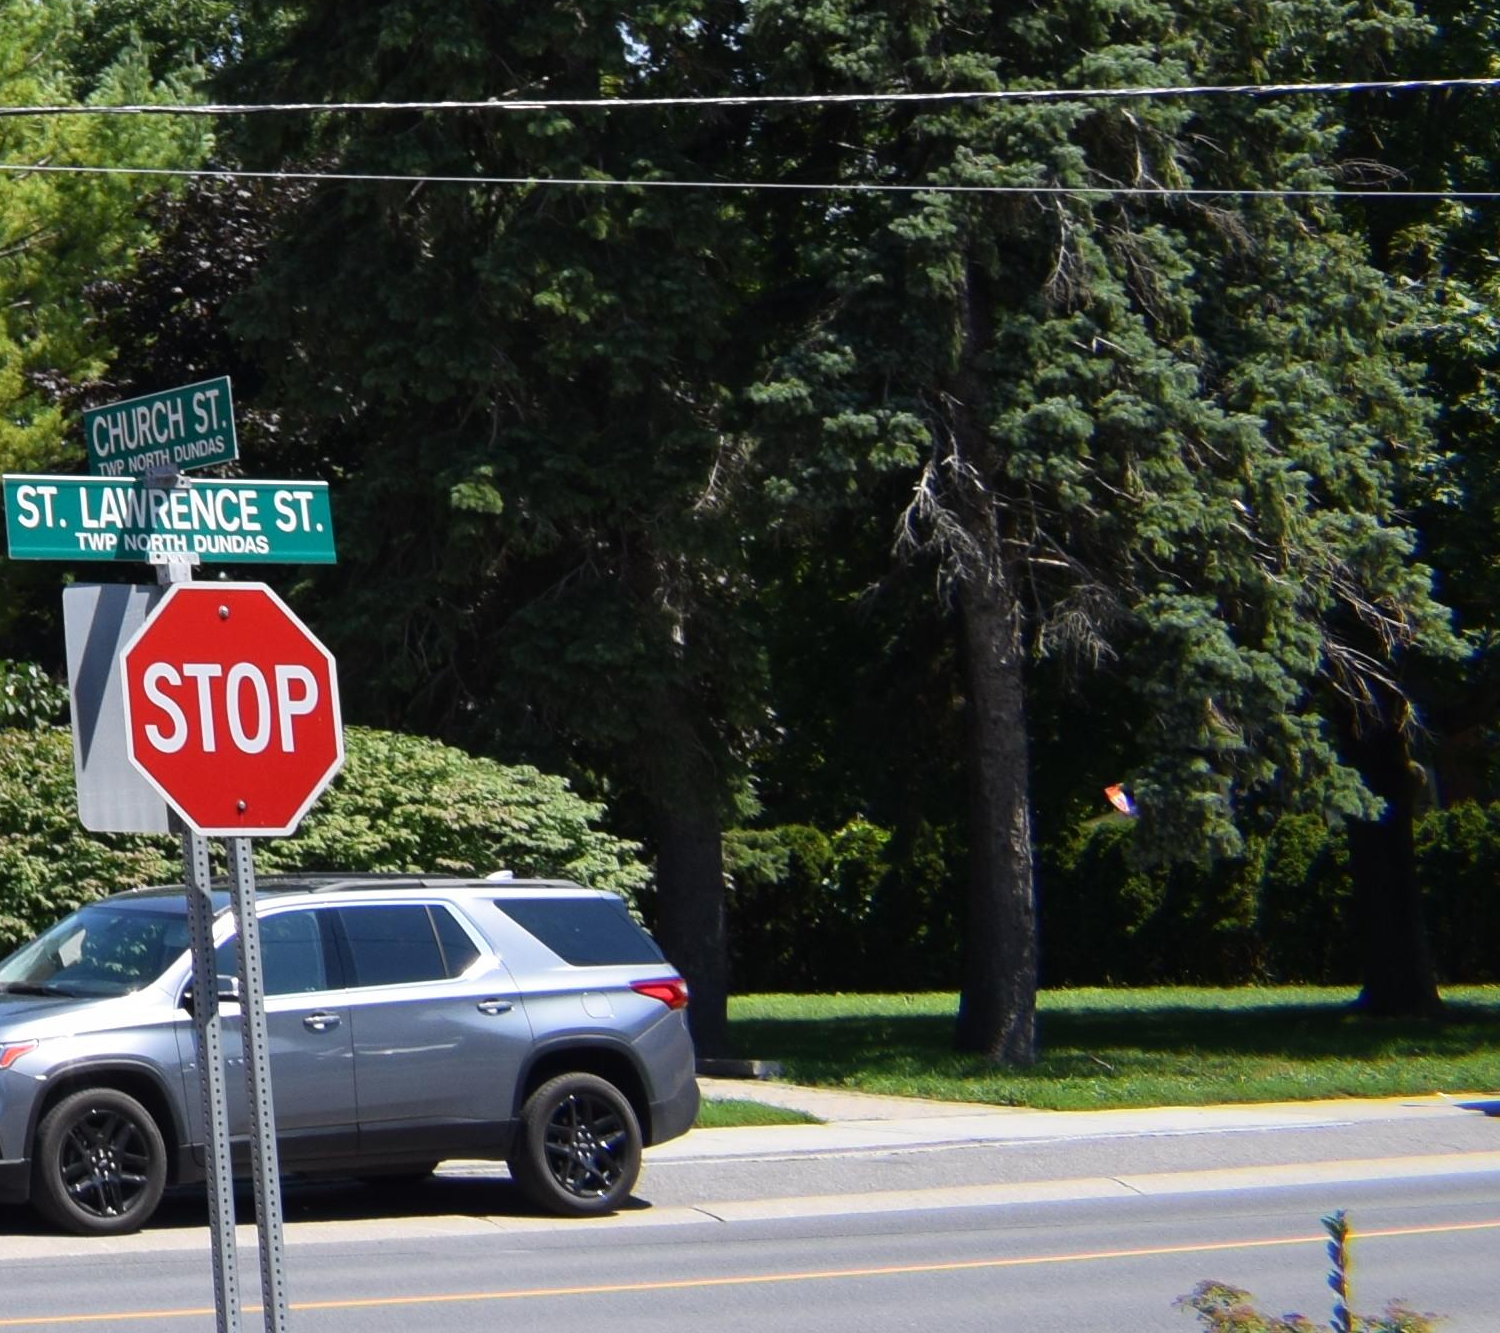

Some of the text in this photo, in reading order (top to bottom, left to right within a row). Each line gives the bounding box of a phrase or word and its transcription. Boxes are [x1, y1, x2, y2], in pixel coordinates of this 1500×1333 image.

[93, 389, 227, 457] CHURCH ST.
[98, 436, 225, 476] TWP NORTH DUNDAS
[16, 485, 323, 533] ST. LAWRENCE ST.
[75, 532, 270, 555] TWP NORTH DUNDAS
[143, 661, 319, 754] STOP
